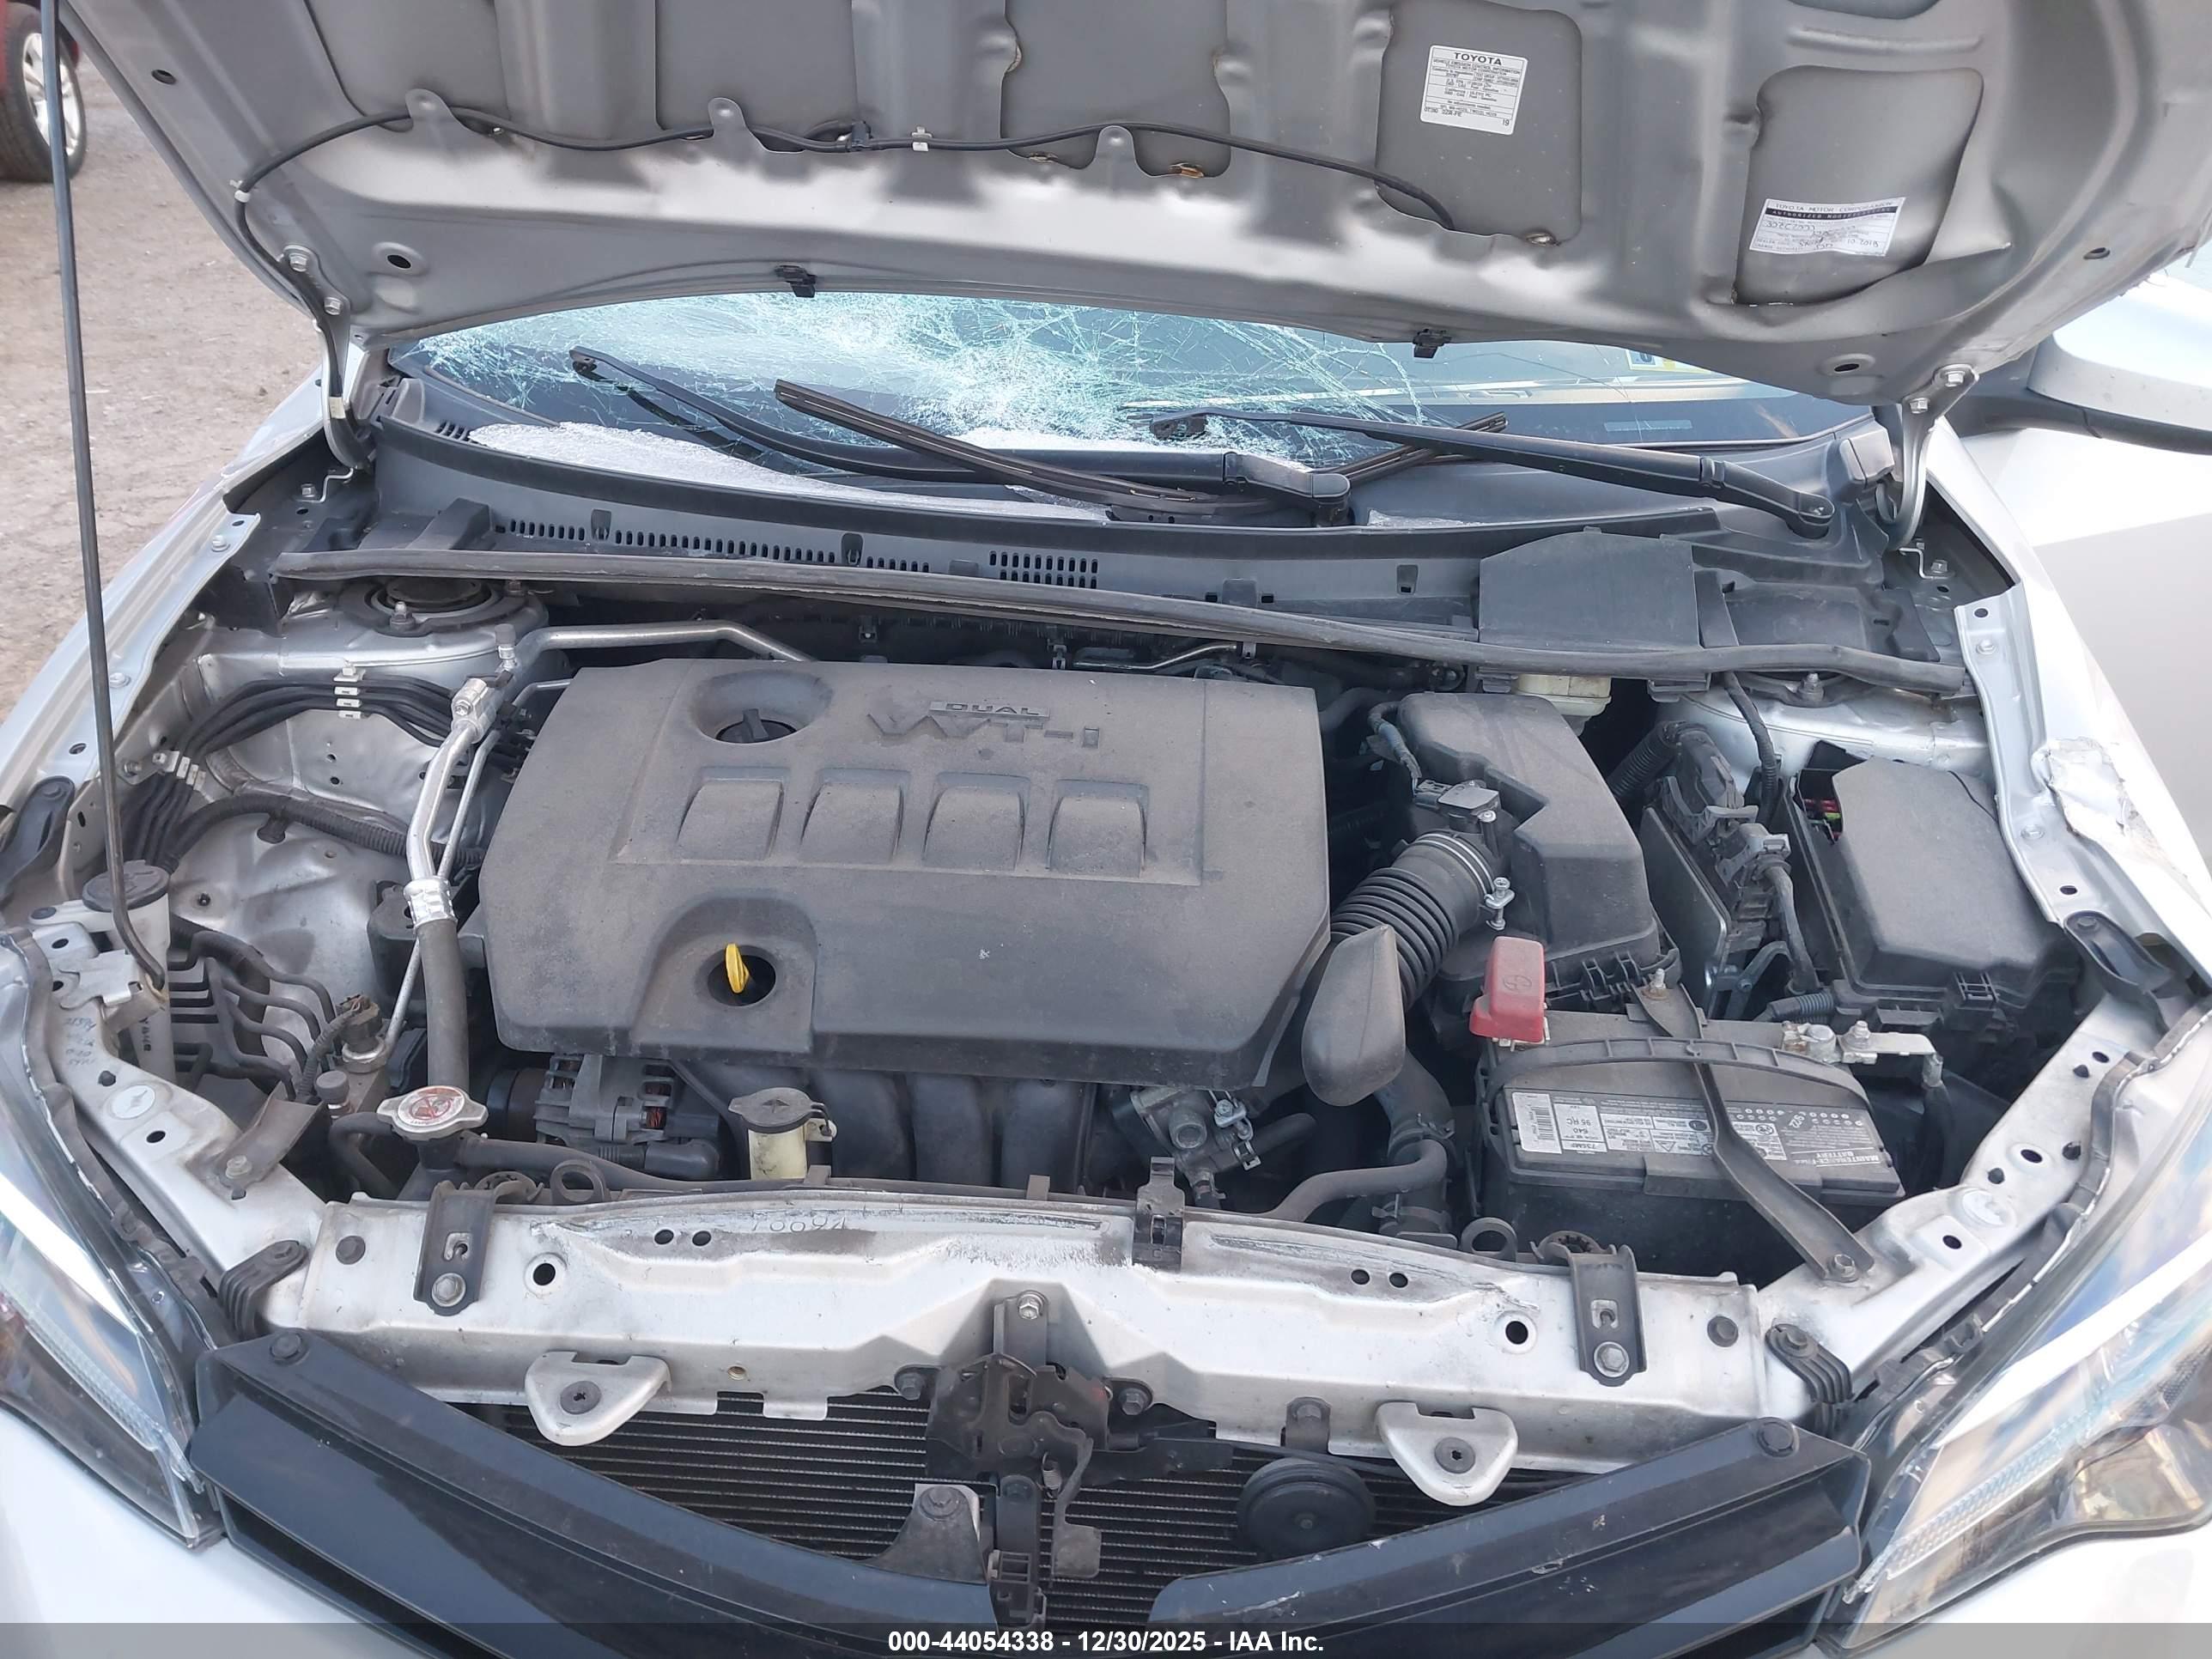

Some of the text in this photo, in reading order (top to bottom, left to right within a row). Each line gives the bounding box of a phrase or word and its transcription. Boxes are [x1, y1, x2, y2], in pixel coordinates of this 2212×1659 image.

[1454, 52, 1502, 65] TOYOTA
[945, 702, 1040, 716] DUAL
[1815, 1151, 1855, 1159] BATTERY
